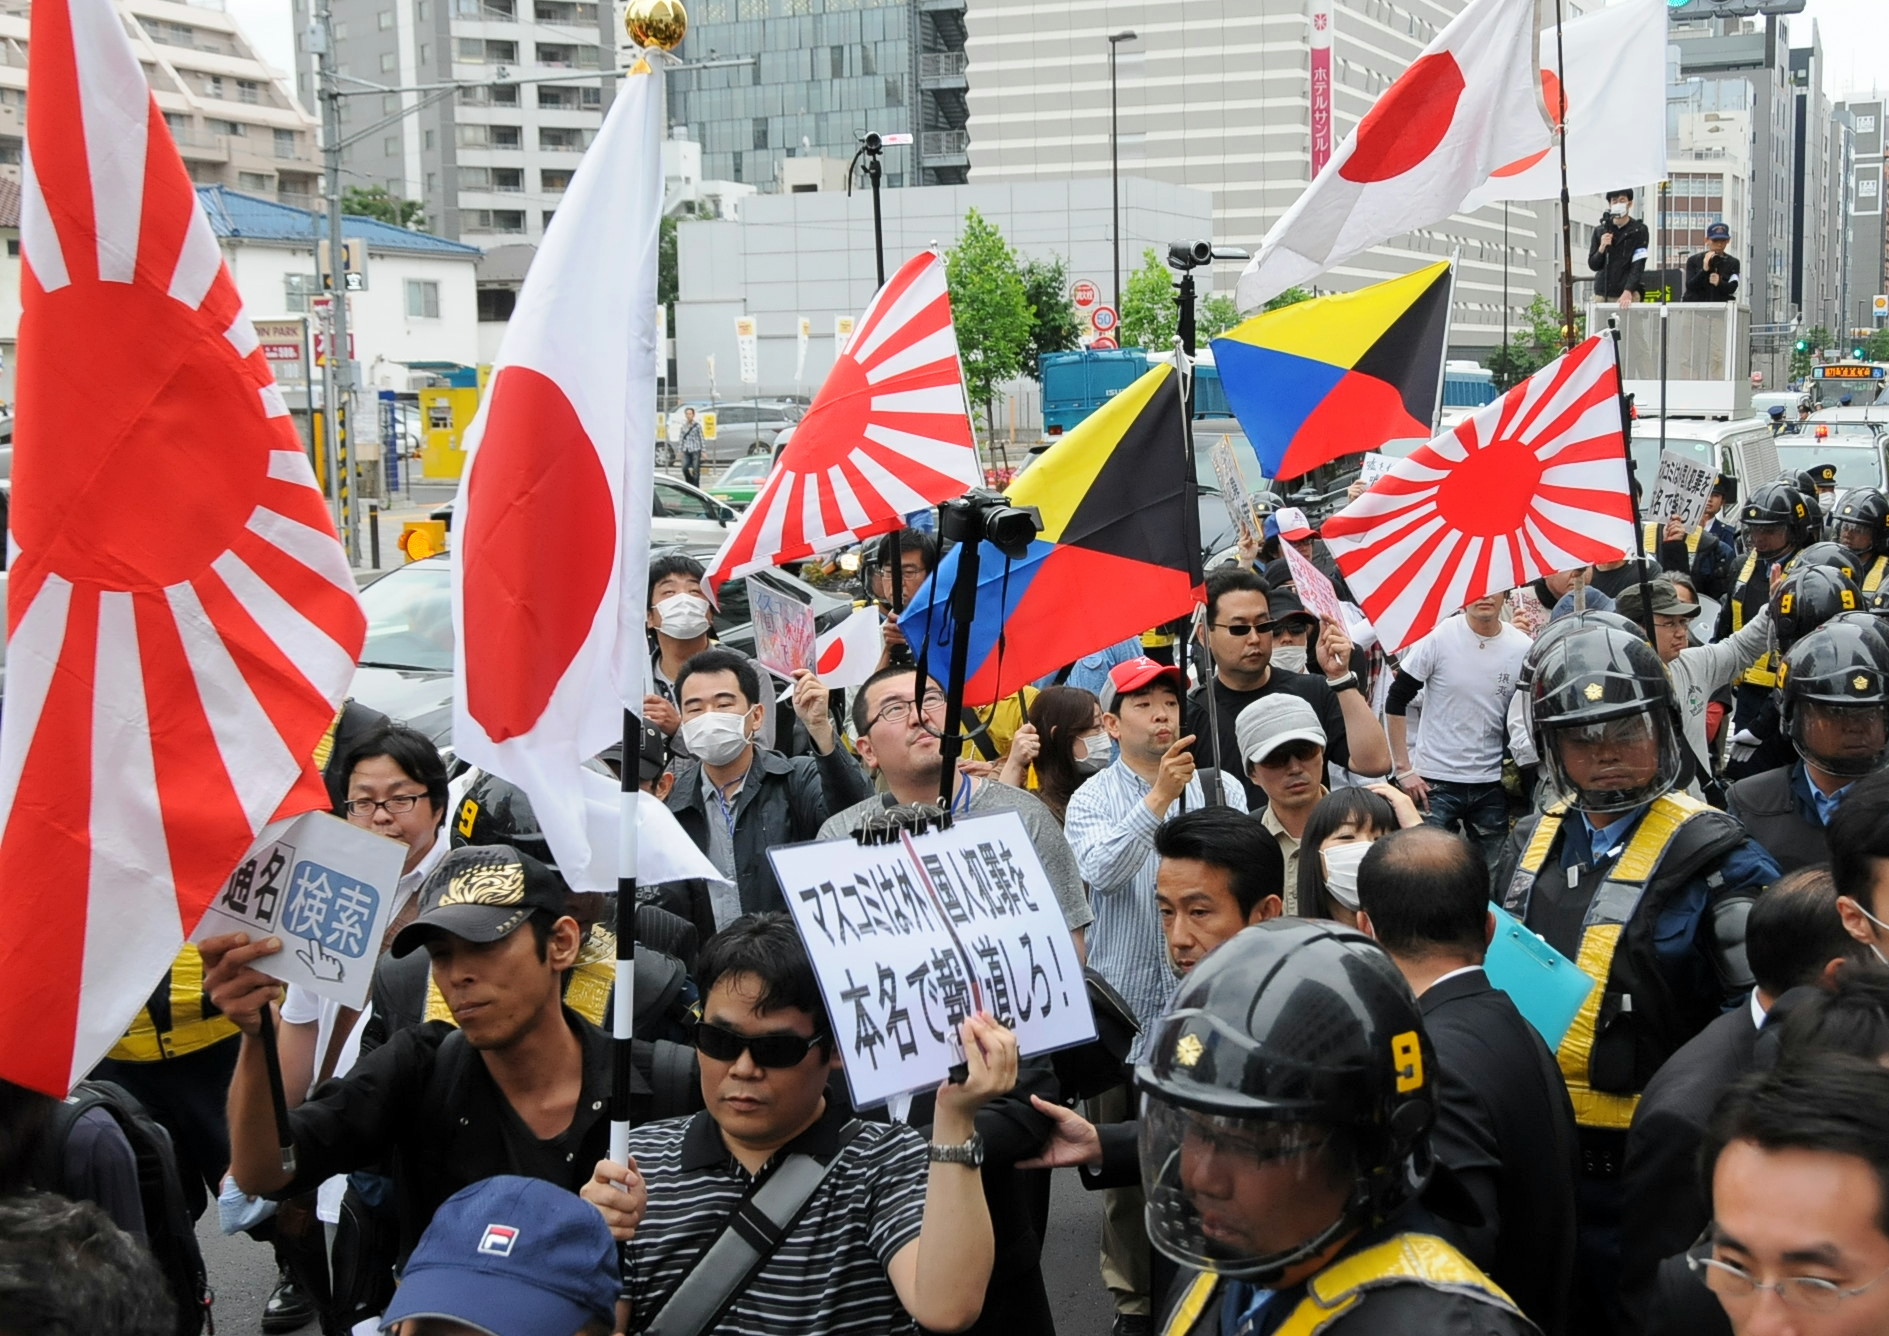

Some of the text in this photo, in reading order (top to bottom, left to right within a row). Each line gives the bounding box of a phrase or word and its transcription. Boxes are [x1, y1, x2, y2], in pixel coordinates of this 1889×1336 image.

[1097, 313, 1112, 326] 50
[273, 325, 299, 337] PARK
[1796, 503, 1806, 518] 9
[1781, 594, 1793, 614] 9
[1841, 590, 1855, 609] 9
[459, 798, 479, 839] 9
[798, 840, 1040, 947] マスコミは外国人犯罪を
[290, 866, 373, 954] 検索
[1391, 1030, 1424, 1093] 9
